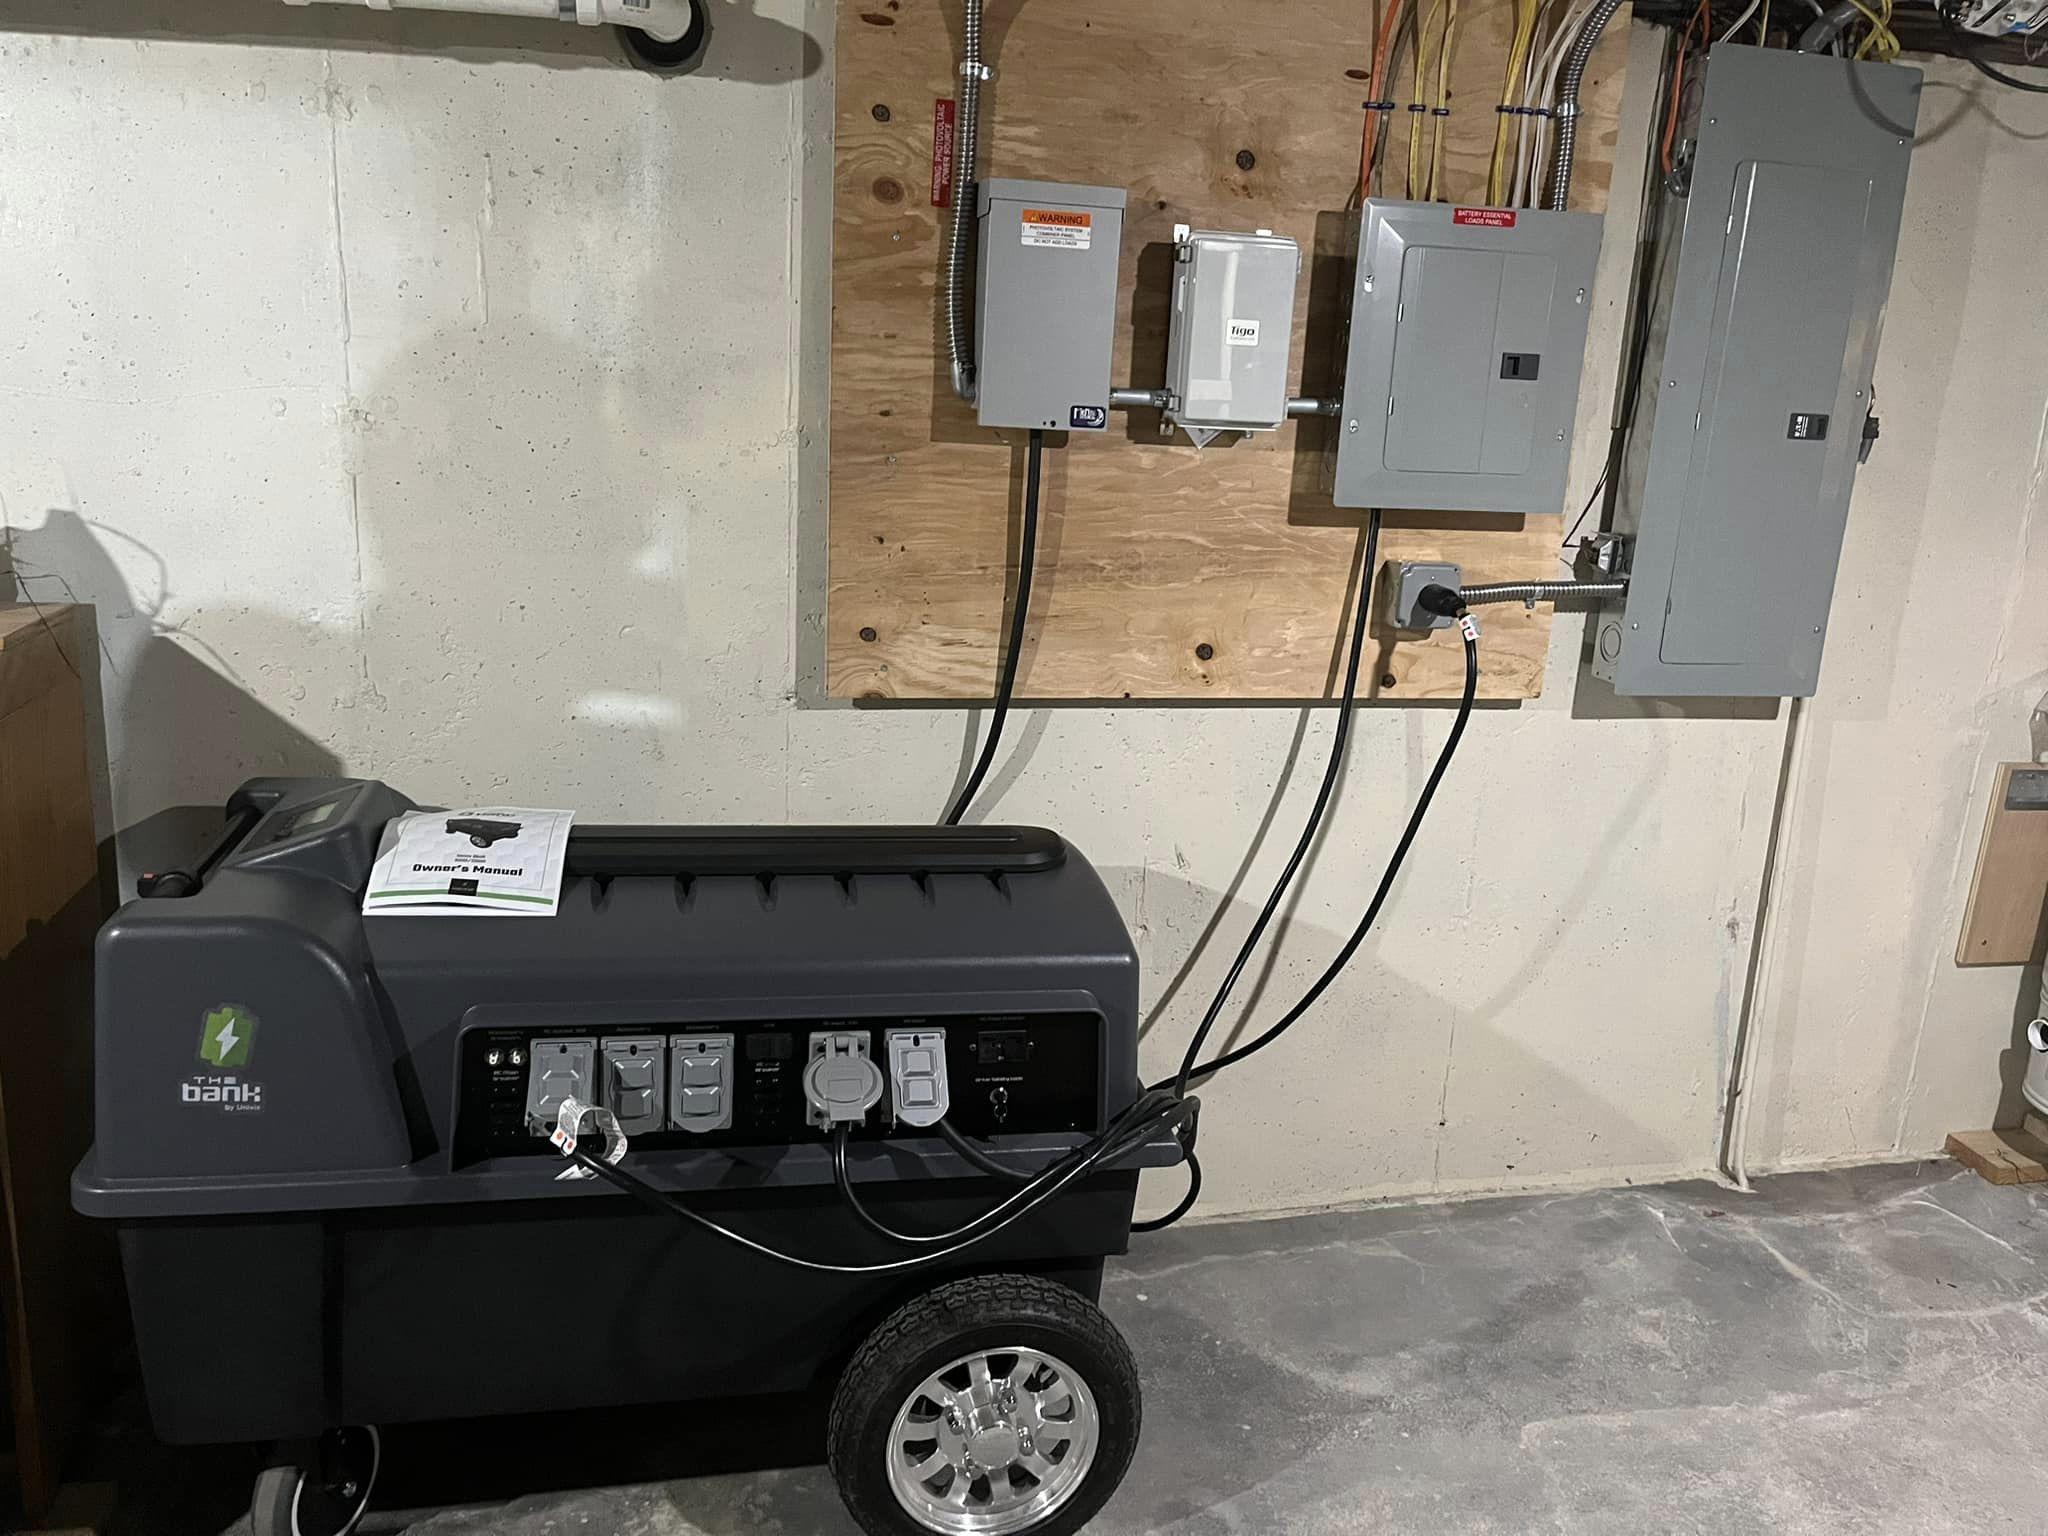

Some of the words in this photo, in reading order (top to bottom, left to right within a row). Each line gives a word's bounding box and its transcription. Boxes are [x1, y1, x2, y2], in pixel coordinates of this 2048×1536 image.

[936, 104, 945, 161] PHOTOVOLTAIC
[944, 123, 952, 155] SOURCE
[942, 156, 950, 184] POWER
[1039, 213, 1083, 225] WARNING
[1483, 211, 1511, 219] ESSENTIAL
[1485, 218, 1503, 226] PANEL
[1231, 326, 1255, 337] Tigo
[412, 863, 469, 872] Owner's
[472, 865, 523, 876] Manual
[193, 1076, 236, 1084] THE
[182, 1083, 261, 1102] bank
